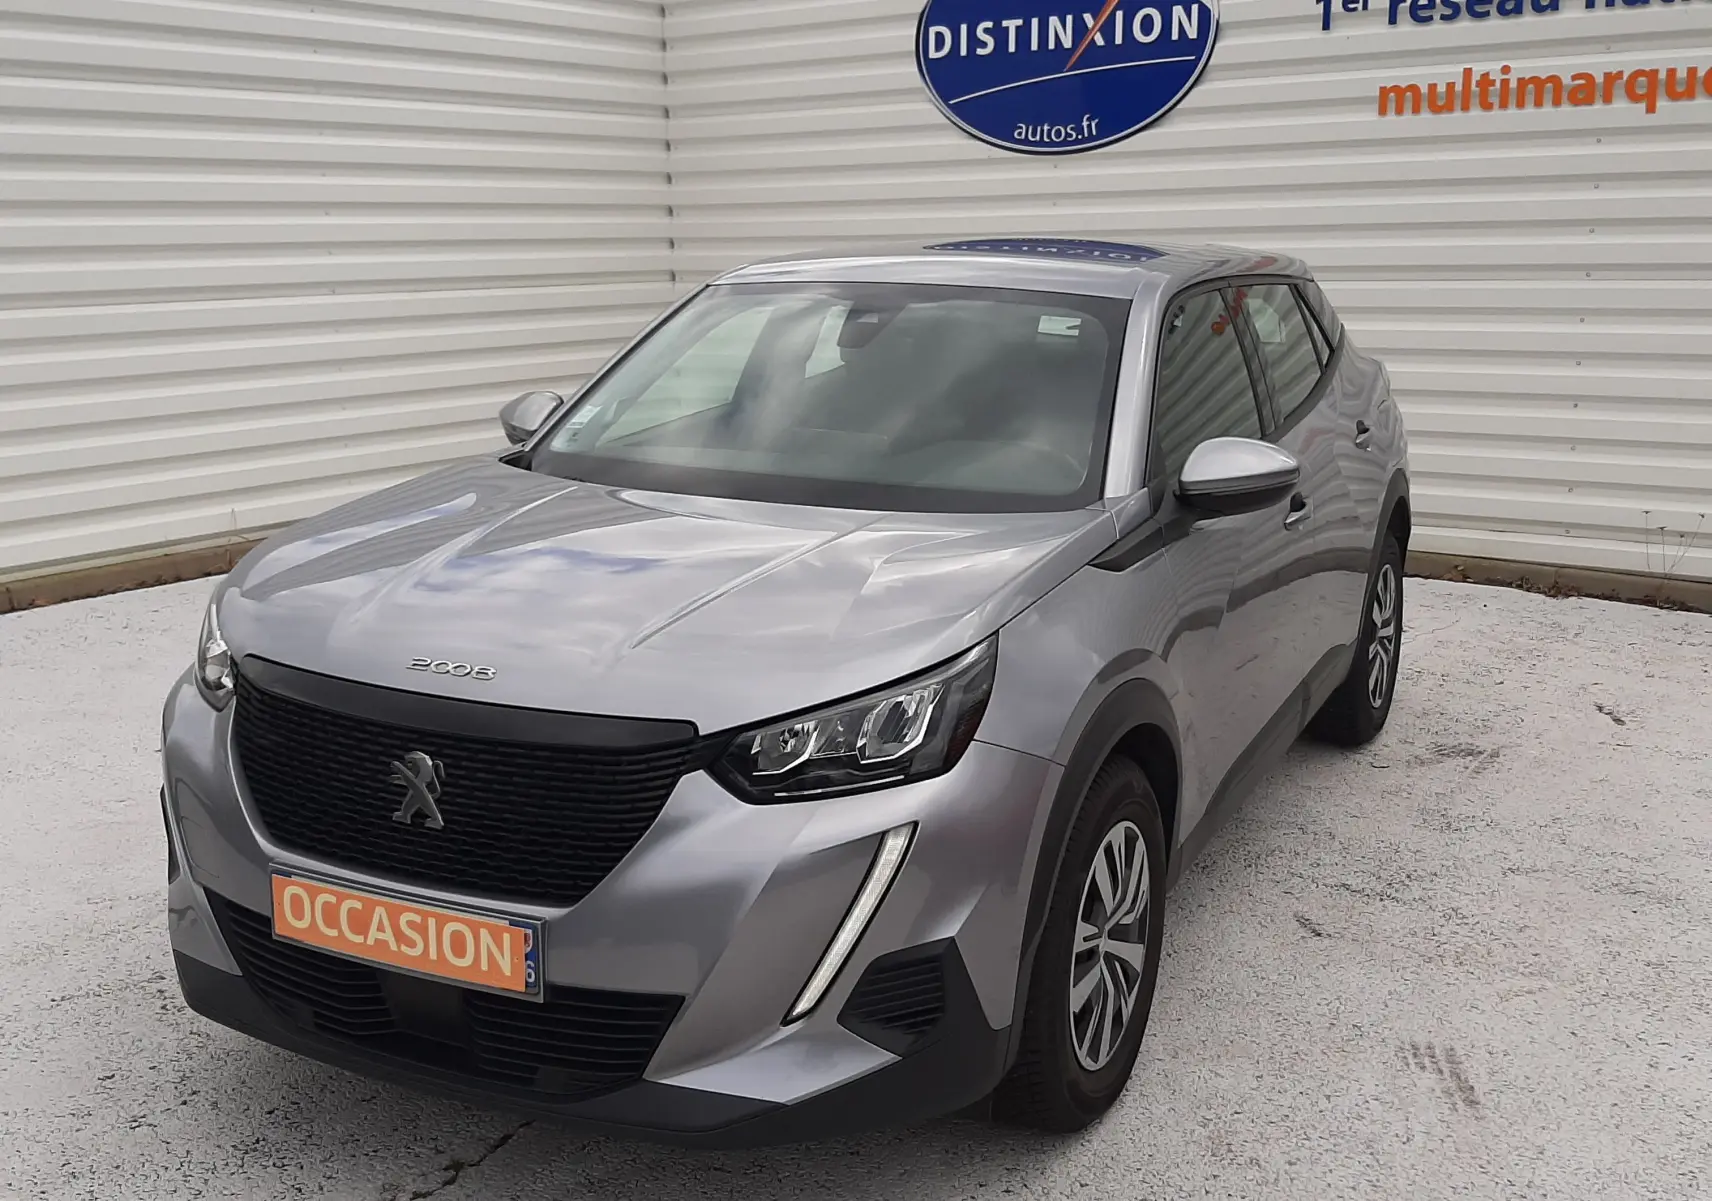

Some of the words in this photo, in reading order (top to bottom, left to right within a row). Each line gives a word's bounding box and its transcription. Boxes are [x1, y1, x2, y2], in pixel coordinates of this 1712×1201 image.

[927, 2, 1200, 60] DISTINXION
[1013, 114, 1100, 142] autos.fr
[405, 656, 498, 681] 2008
[283, 885, 512, 976] OCCASION
